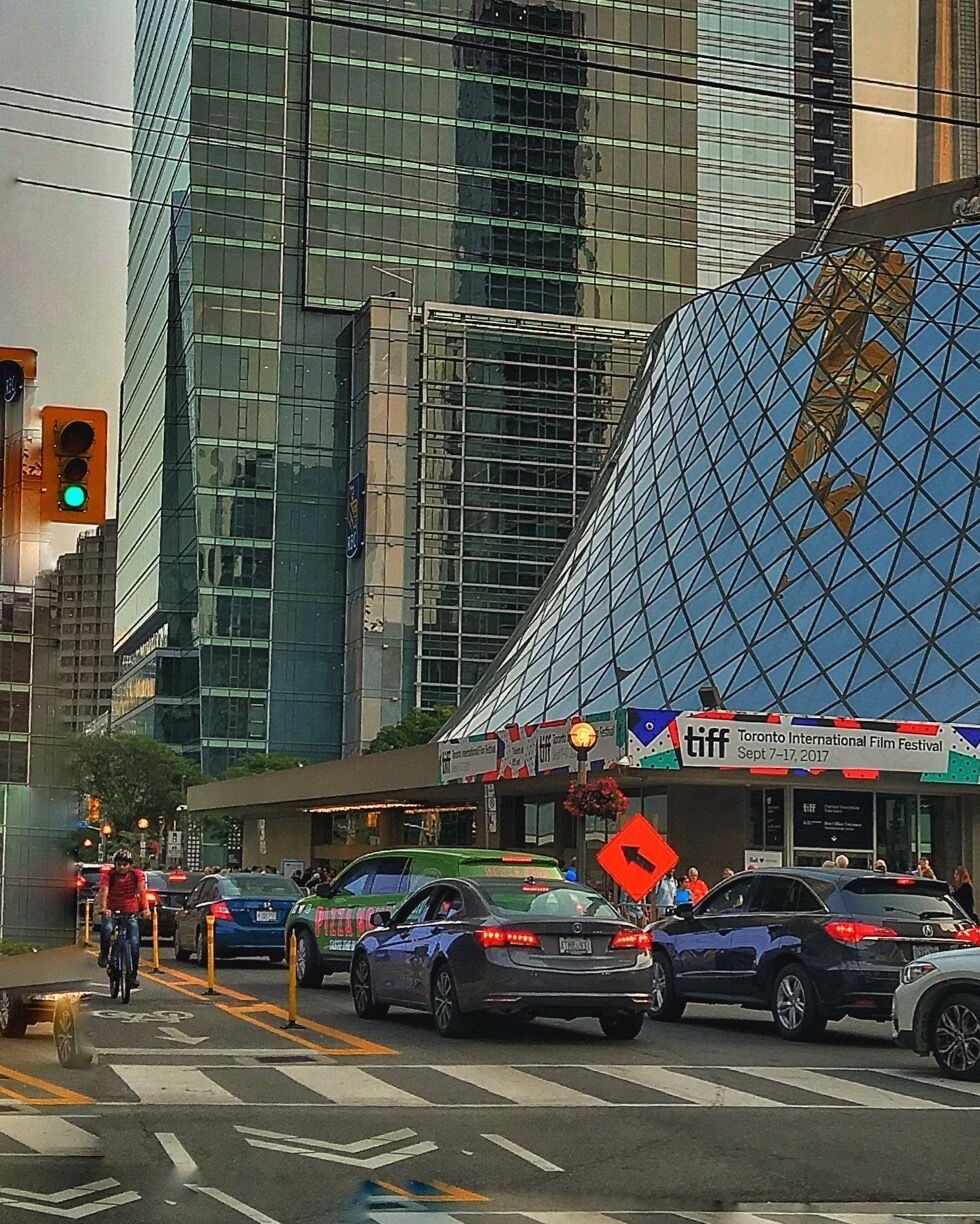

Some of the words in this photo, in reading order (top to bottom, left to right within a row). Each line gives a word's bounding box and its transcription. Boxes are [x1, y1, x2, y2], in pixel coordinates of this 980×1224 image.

[683, 726, 731, 759] tiff
[737, 729, 788, 744] Toronto
[788, 730, 867, 748] International
[869, 735, 896, 750] Film
[898, 737, 944, 753] Festival
[737, 746, 767, 762] Sept
[800, 749, 830, 763] 2017
[314, 906, 354, 937] PIZZA
